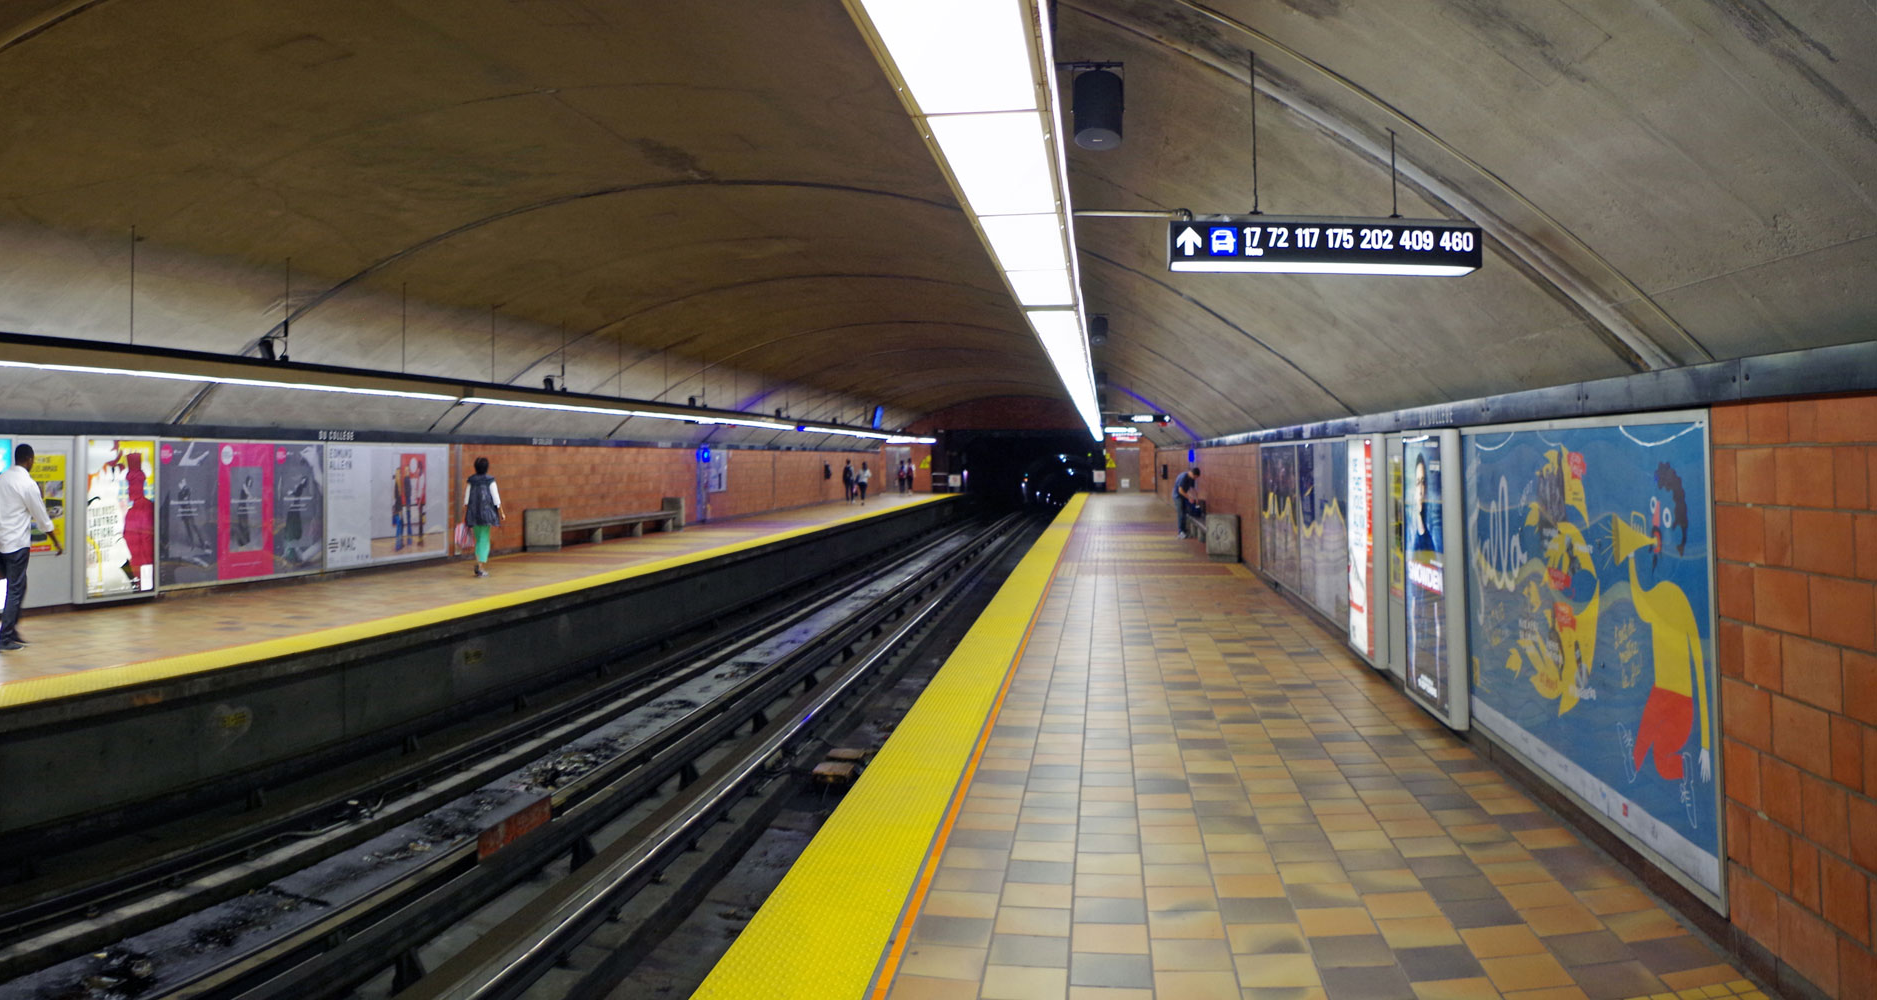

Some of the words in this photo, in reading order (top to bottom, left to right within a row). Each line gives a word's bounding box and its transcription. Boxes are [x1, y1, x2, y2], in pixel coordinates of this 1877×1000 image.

[1243, 227, 1262, 247] 17
[1267, 227, 1289, 248] 72
[1295, 228, 1320, 248] 117
[1325, 228, 1354, 249] 175
[1359, 229, 1394, 250] 202
[1399, 230, 1434, 250] 409
[1439, 231, 1474, 252] 460
[1408, 560, 1443, 593] SNOWDEN
